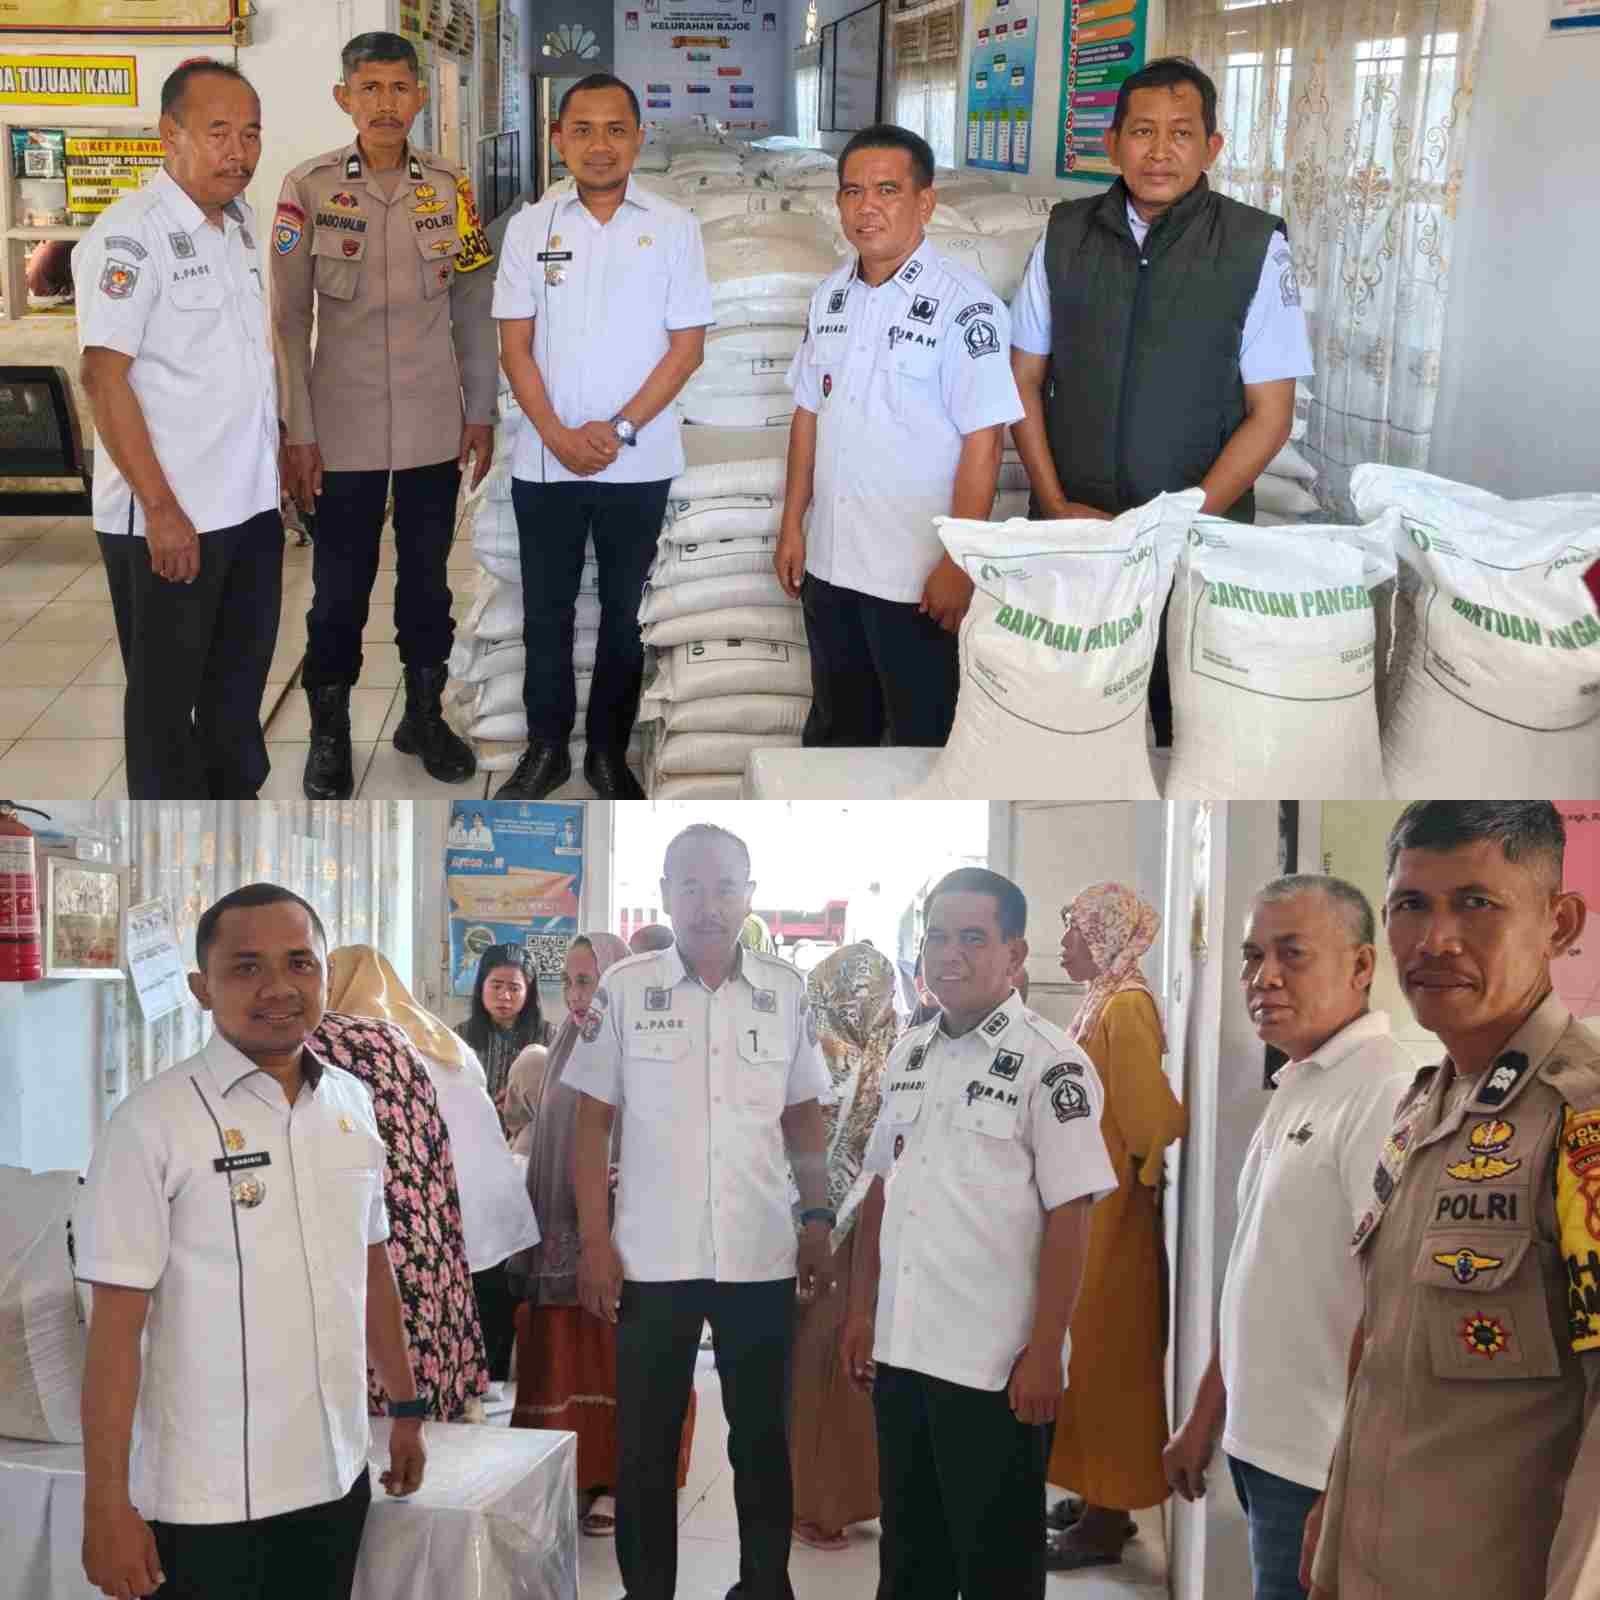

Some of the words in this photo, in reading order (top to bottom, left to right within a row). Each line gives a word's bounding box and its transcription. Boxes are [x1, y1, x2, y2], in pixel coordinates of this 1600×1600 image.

[651, 22, 714, 30] KELURAHAN
[17, 67, 81, 93] TUJUAN
[84, 69, 129, 94] KAMI
[415, 214, 454, 232] POLRI
[995, 606, 1083, 653] BANTUAN
[1436, 1193, 1517, 1223] POLRI
